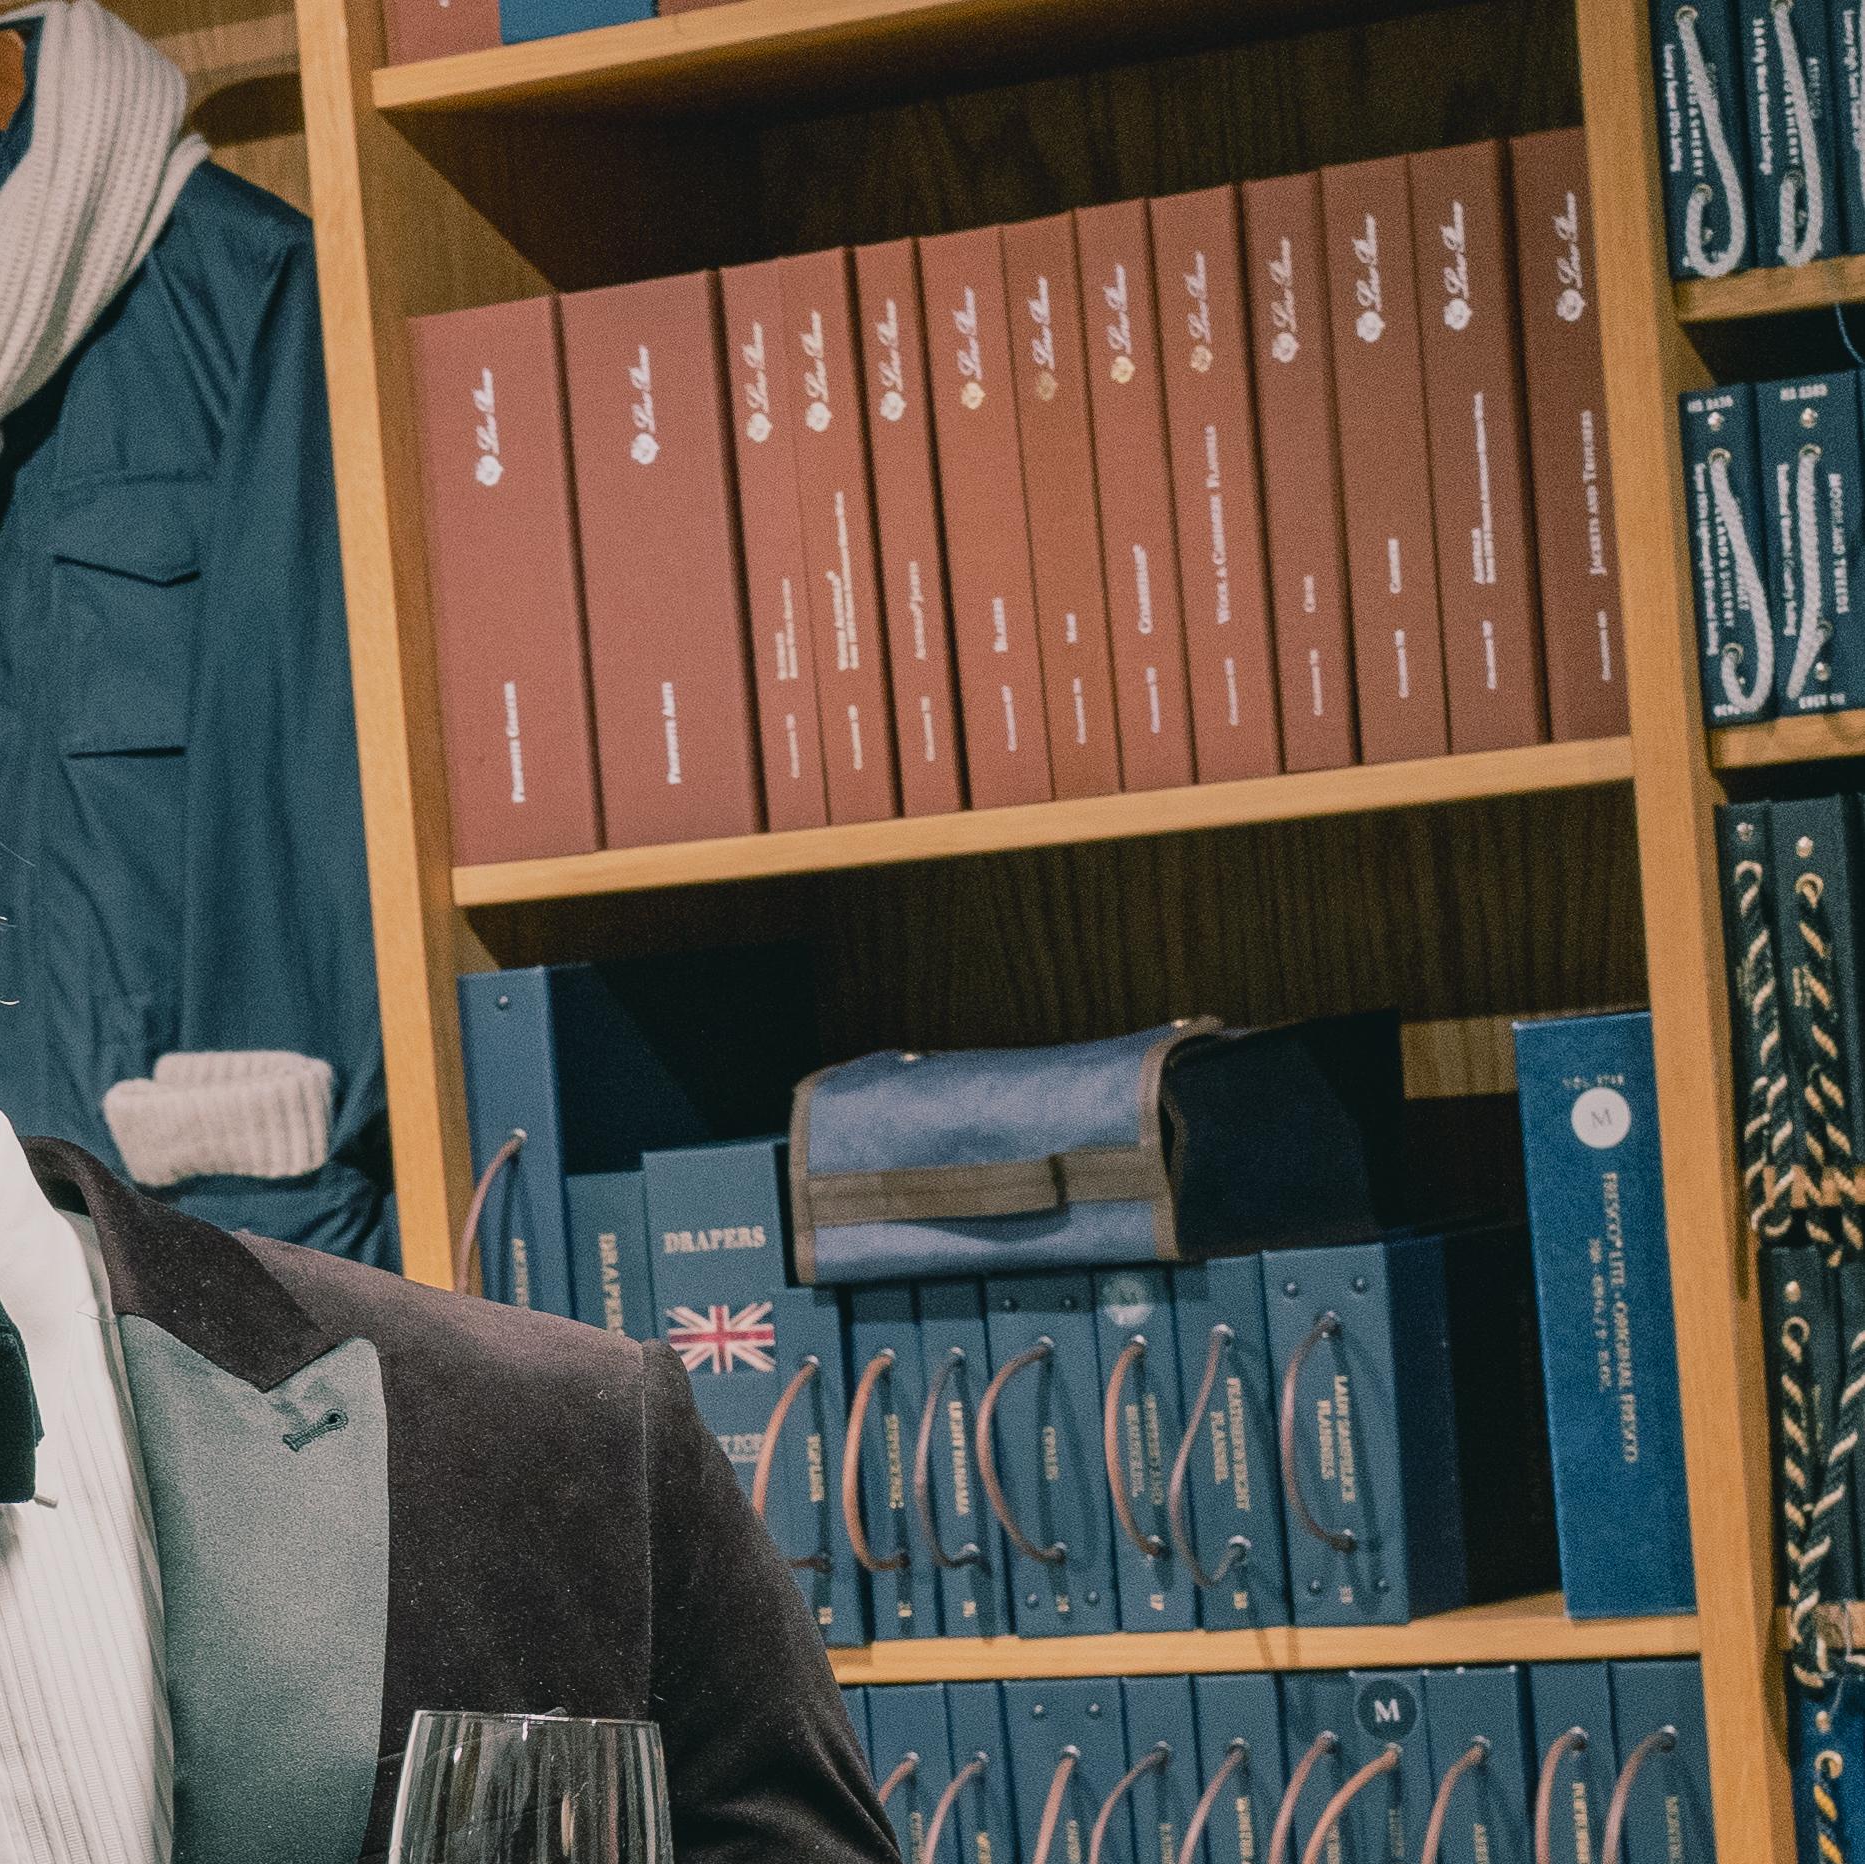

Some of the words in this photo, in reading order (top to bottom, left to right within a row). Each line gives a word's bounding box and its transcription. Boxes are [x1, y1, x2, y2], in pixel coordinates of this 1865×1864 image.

[1719, 570, 1734, 629] SHERRY
[1832, 557, 1850, 614] TWEEDS
[1590, 1108, 1612, 1129] M
[662, 1225, 766, 1254] DRAPERS
[1618, 1392, 1637, 1463] FRESCO
[1374, 1699, 1400, 1723] M
